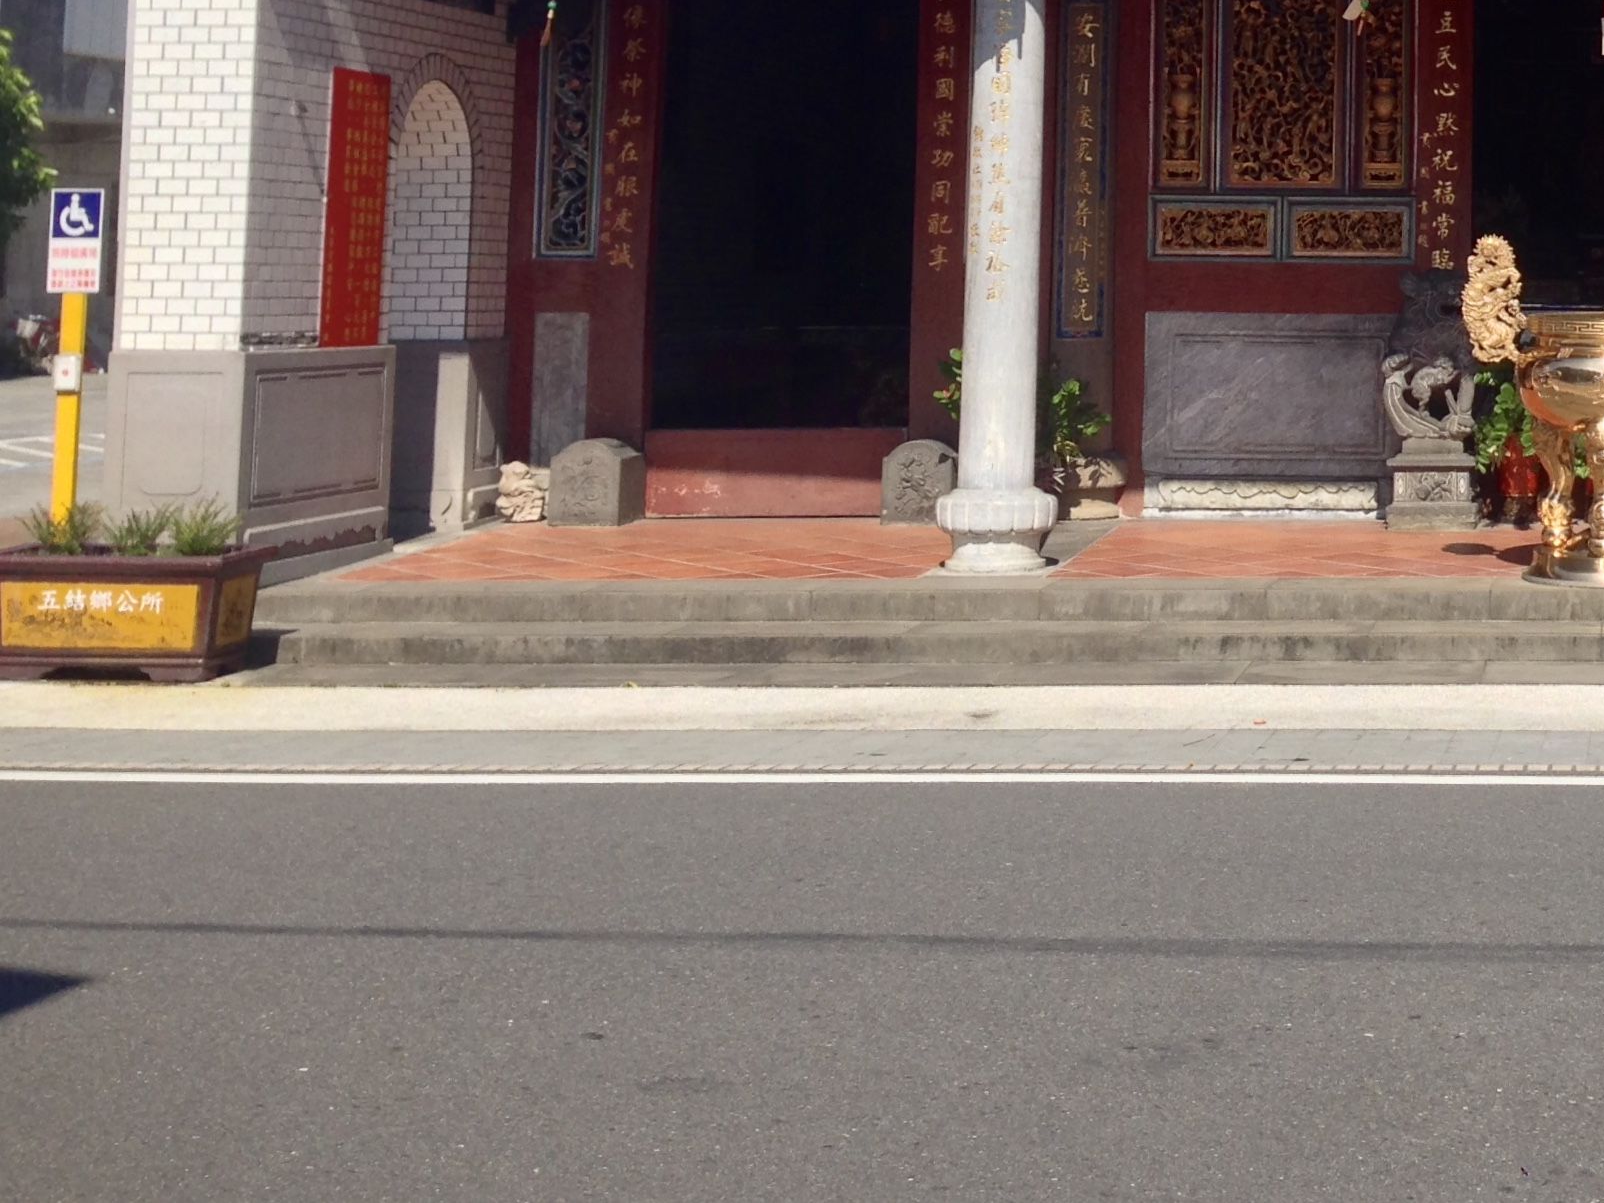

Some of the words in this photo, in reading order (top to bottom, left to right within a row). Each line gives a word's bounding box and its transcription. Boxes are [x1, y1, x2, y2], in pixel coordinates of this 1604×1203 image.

[37, 588, 165, 615] 五結鄉公所
